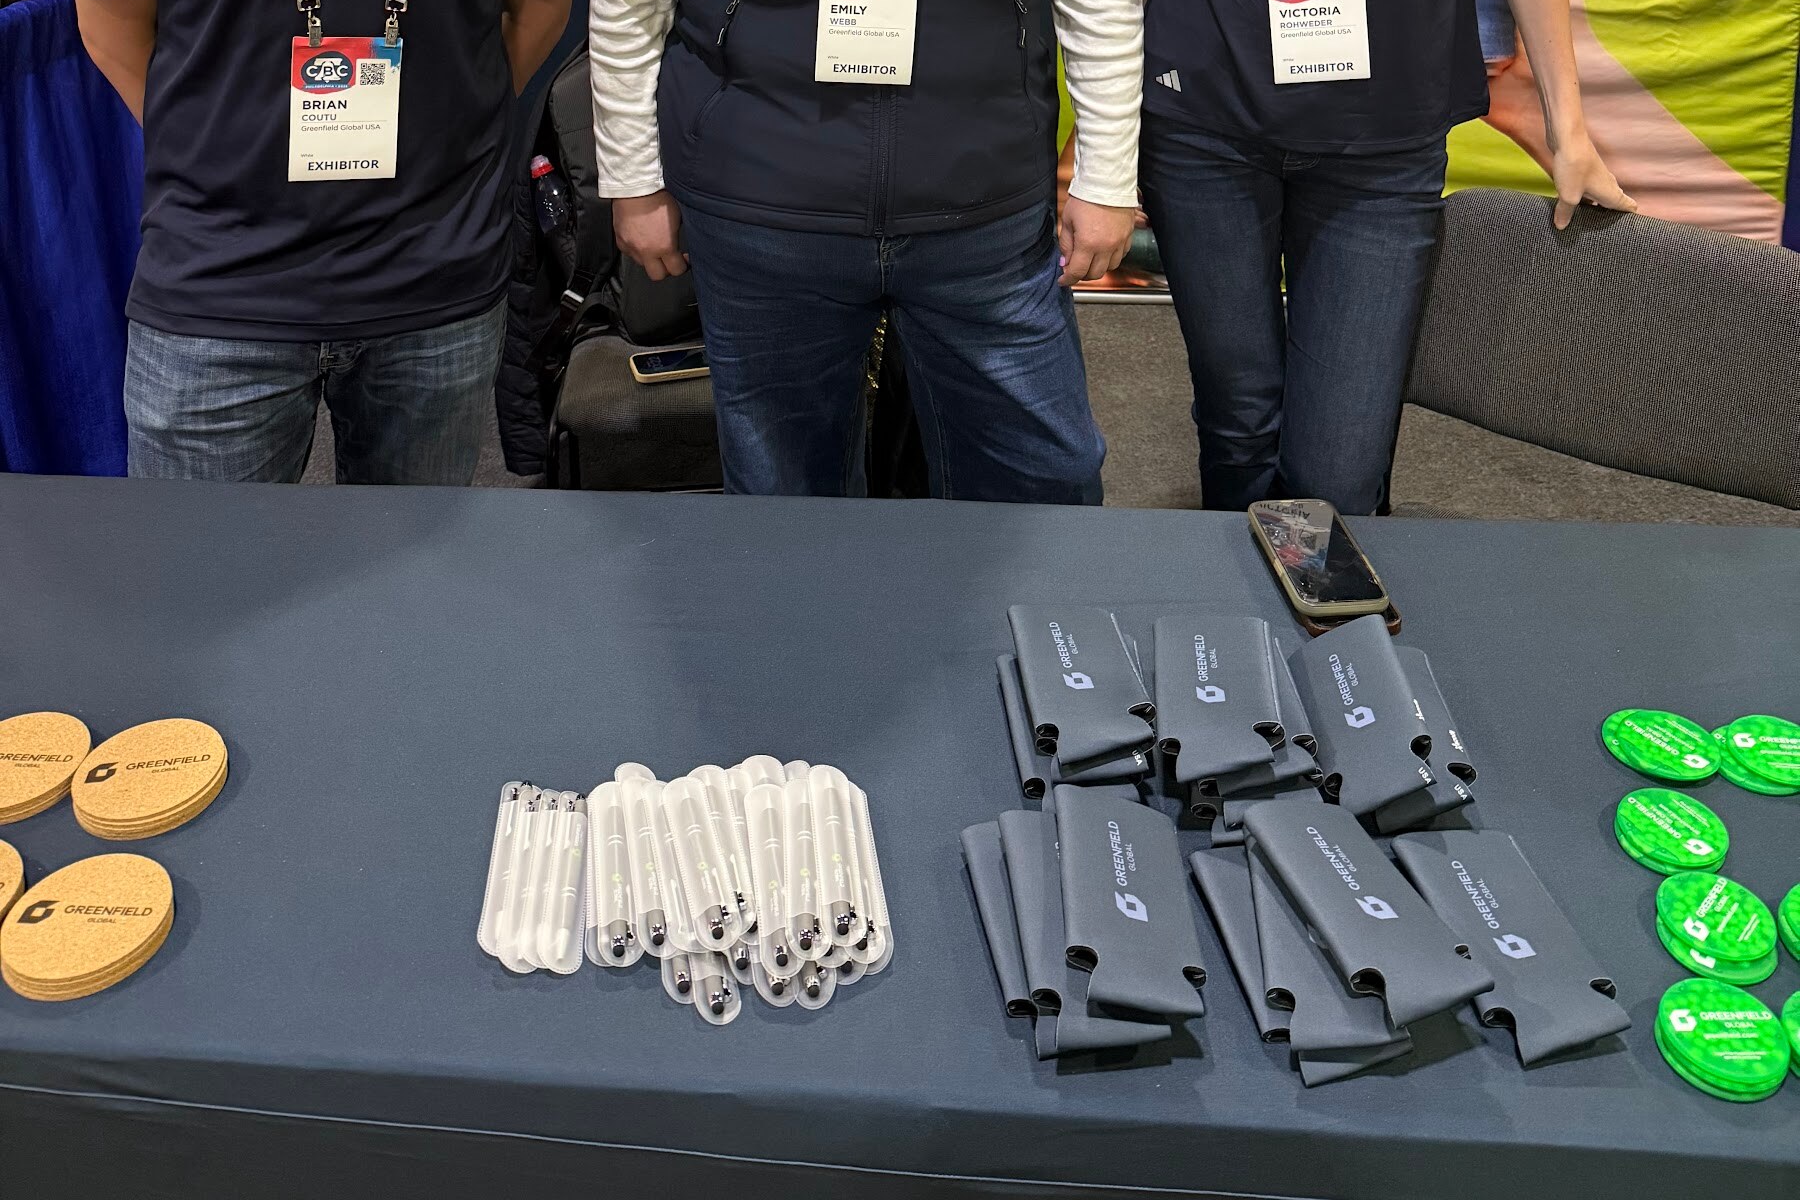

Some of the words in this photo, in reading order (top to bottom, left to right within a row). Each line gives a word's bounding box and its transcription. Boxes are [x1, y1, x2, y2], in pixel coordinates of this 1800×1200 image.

[830, 4, 867, 15] EMILY
[1279, 6, 1341, 18] VICTORIA
[830, 18, 857, 26] WEBB
[1280, 19, 1333, 29] ROHWEDER
[1280, 31, 1313, 39] Greenfield
[1315, 29, 1336, 37] Global
[305, 65, 349, 77] CBC
[833, 63, 897, 75] EXHIBITOR
[1290, 62, 1354, 75] EXHIBITOR
[302, 100, 347, 110] BRIAN
[301, 124, 339, 132] Greenfield
[308, 160, 379, 171] EXHIBITOR
[1049, 621, 1073, 669] GREENFIELD
[1064, 633, 1079, 655] GLOBAL
[1194, 634, 1208, 682] GREENFIELD
[1328, 654, 1354, 706] GREENFIELD
[1345, 662, 1359, 687] GLOBAL
[126, 753, 211, 770] GREENFIELD
[1418, 766, 1432, 784] USA
[1454, 784, 1468, 801] USA
[1107, 820, 1128, 887] GREENFIELD
[1126, 843, 1137, 872] GLOBAL
[1306, 826, 1360, 891] GREENFIELD
[1332, 844, 1357, 872] GLOBAL
[1452, 860, 1500, 930] GREENFIELD
[1477, 878, 1499, 909] GLOBAL
[64, 904, 153, 917] GREENFIELD
[1700, 1011, 1772, 1021] GREENFIELD
